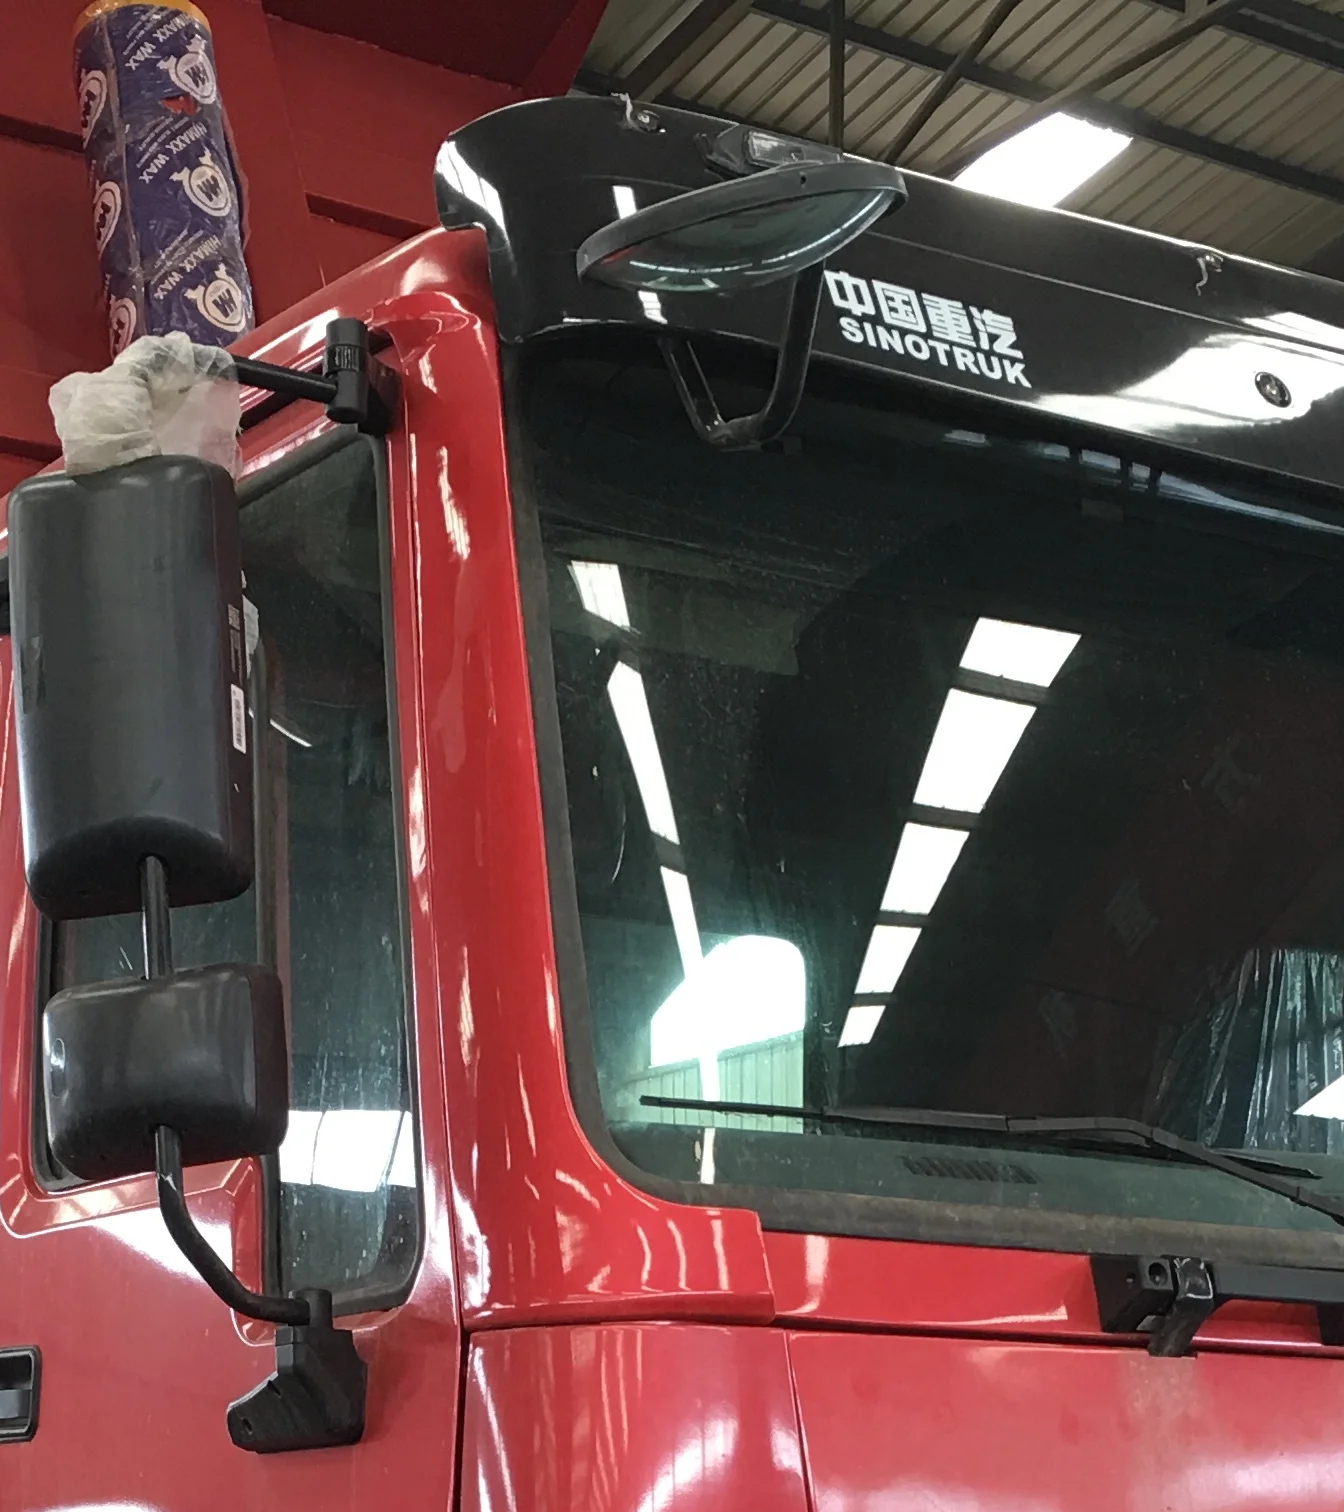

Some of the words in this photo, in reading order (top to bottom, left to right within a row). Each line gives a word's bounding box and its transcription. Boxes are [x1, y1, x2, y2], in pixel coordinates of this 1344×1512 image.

[124, 41, 156, 70] WAX
[138, 153, 170, 184] WAX
[179, 234, 222, 272] HIMAXX
[154, 271, 184, 300] WAX
[824, 270, 1024, 359] 中国重汽
[839, 316, 1032, 389] SINOTRUK
